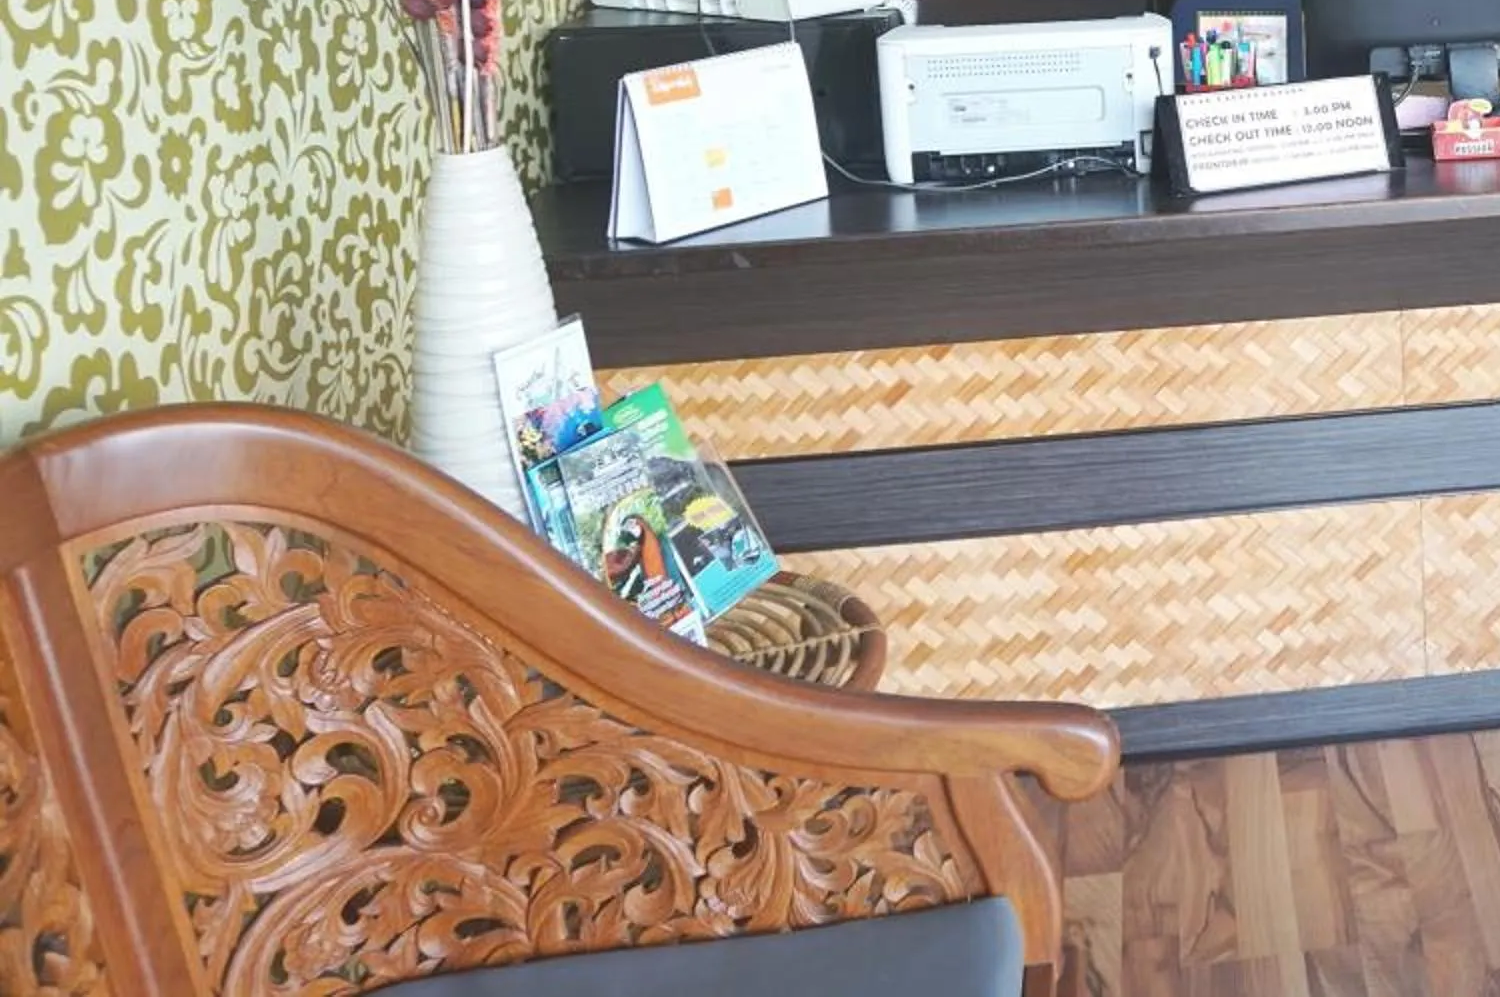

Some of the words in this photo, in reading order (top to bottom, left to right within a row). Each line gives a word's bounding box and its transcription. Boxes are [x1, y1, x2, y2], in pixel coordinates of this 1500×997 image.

[1185, 115, 1229, 130] CHECK
[1231, 113, 1246, 125] IN
[1248, 108, 1279, 122] TIME
[1188, 131, 1232, 147] CHECK
[1235, 129, 1260, 142] OUT
[1263, 124, 1293, 138] TIME
[1335, 115, 1374, 130] NOON
